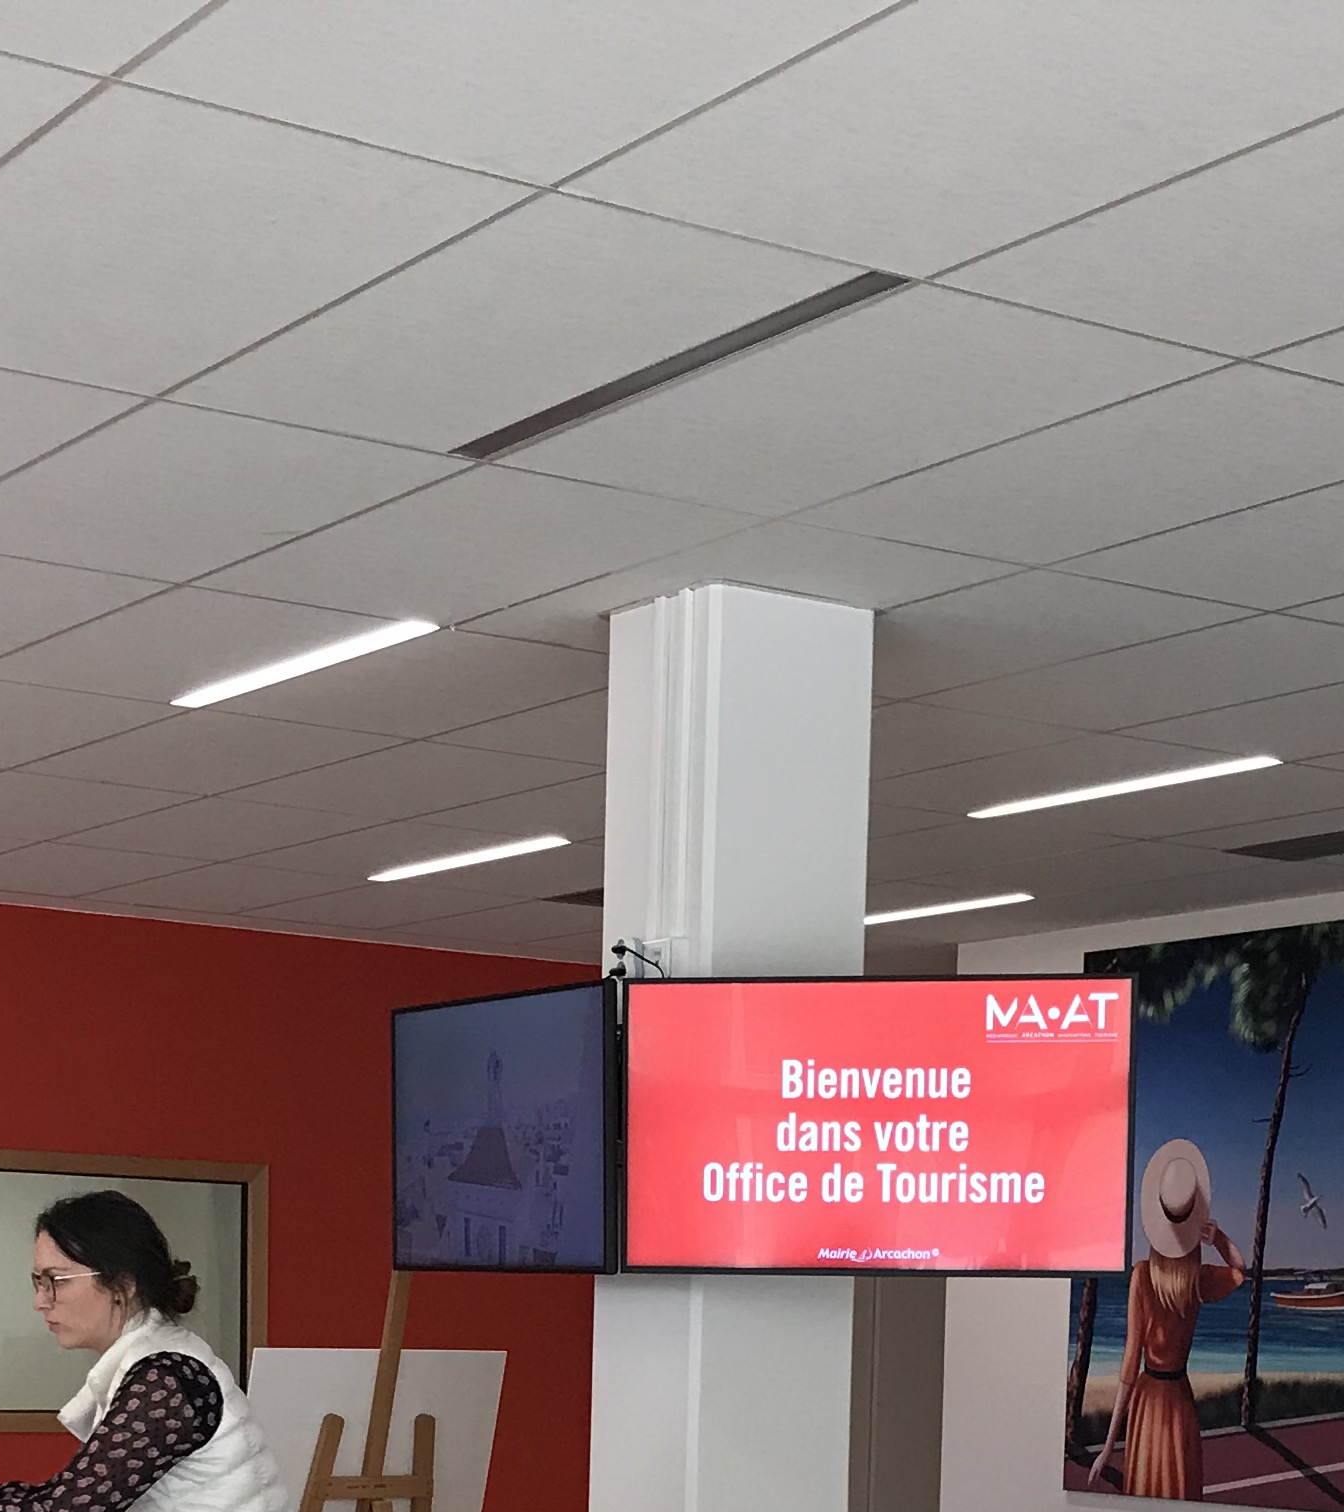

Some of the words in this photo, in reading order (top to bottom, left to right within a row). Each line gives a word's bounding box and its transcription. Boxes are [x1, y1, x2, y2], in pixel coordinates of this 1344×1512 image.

[781, 1059, 972, 1099] Bienvenue
[776, 1112, 862, 1153] dans
[873, 1113, 970, 1153] votre
[702, 1161, 809, 1203] Office
[821, 1162, 865, 1203] de
[876, 1163, 1046, 1204] Tourisme
[817, 1247, 858, 1260] Mairie
[872, 1247, 931, 1260] Arcachon
